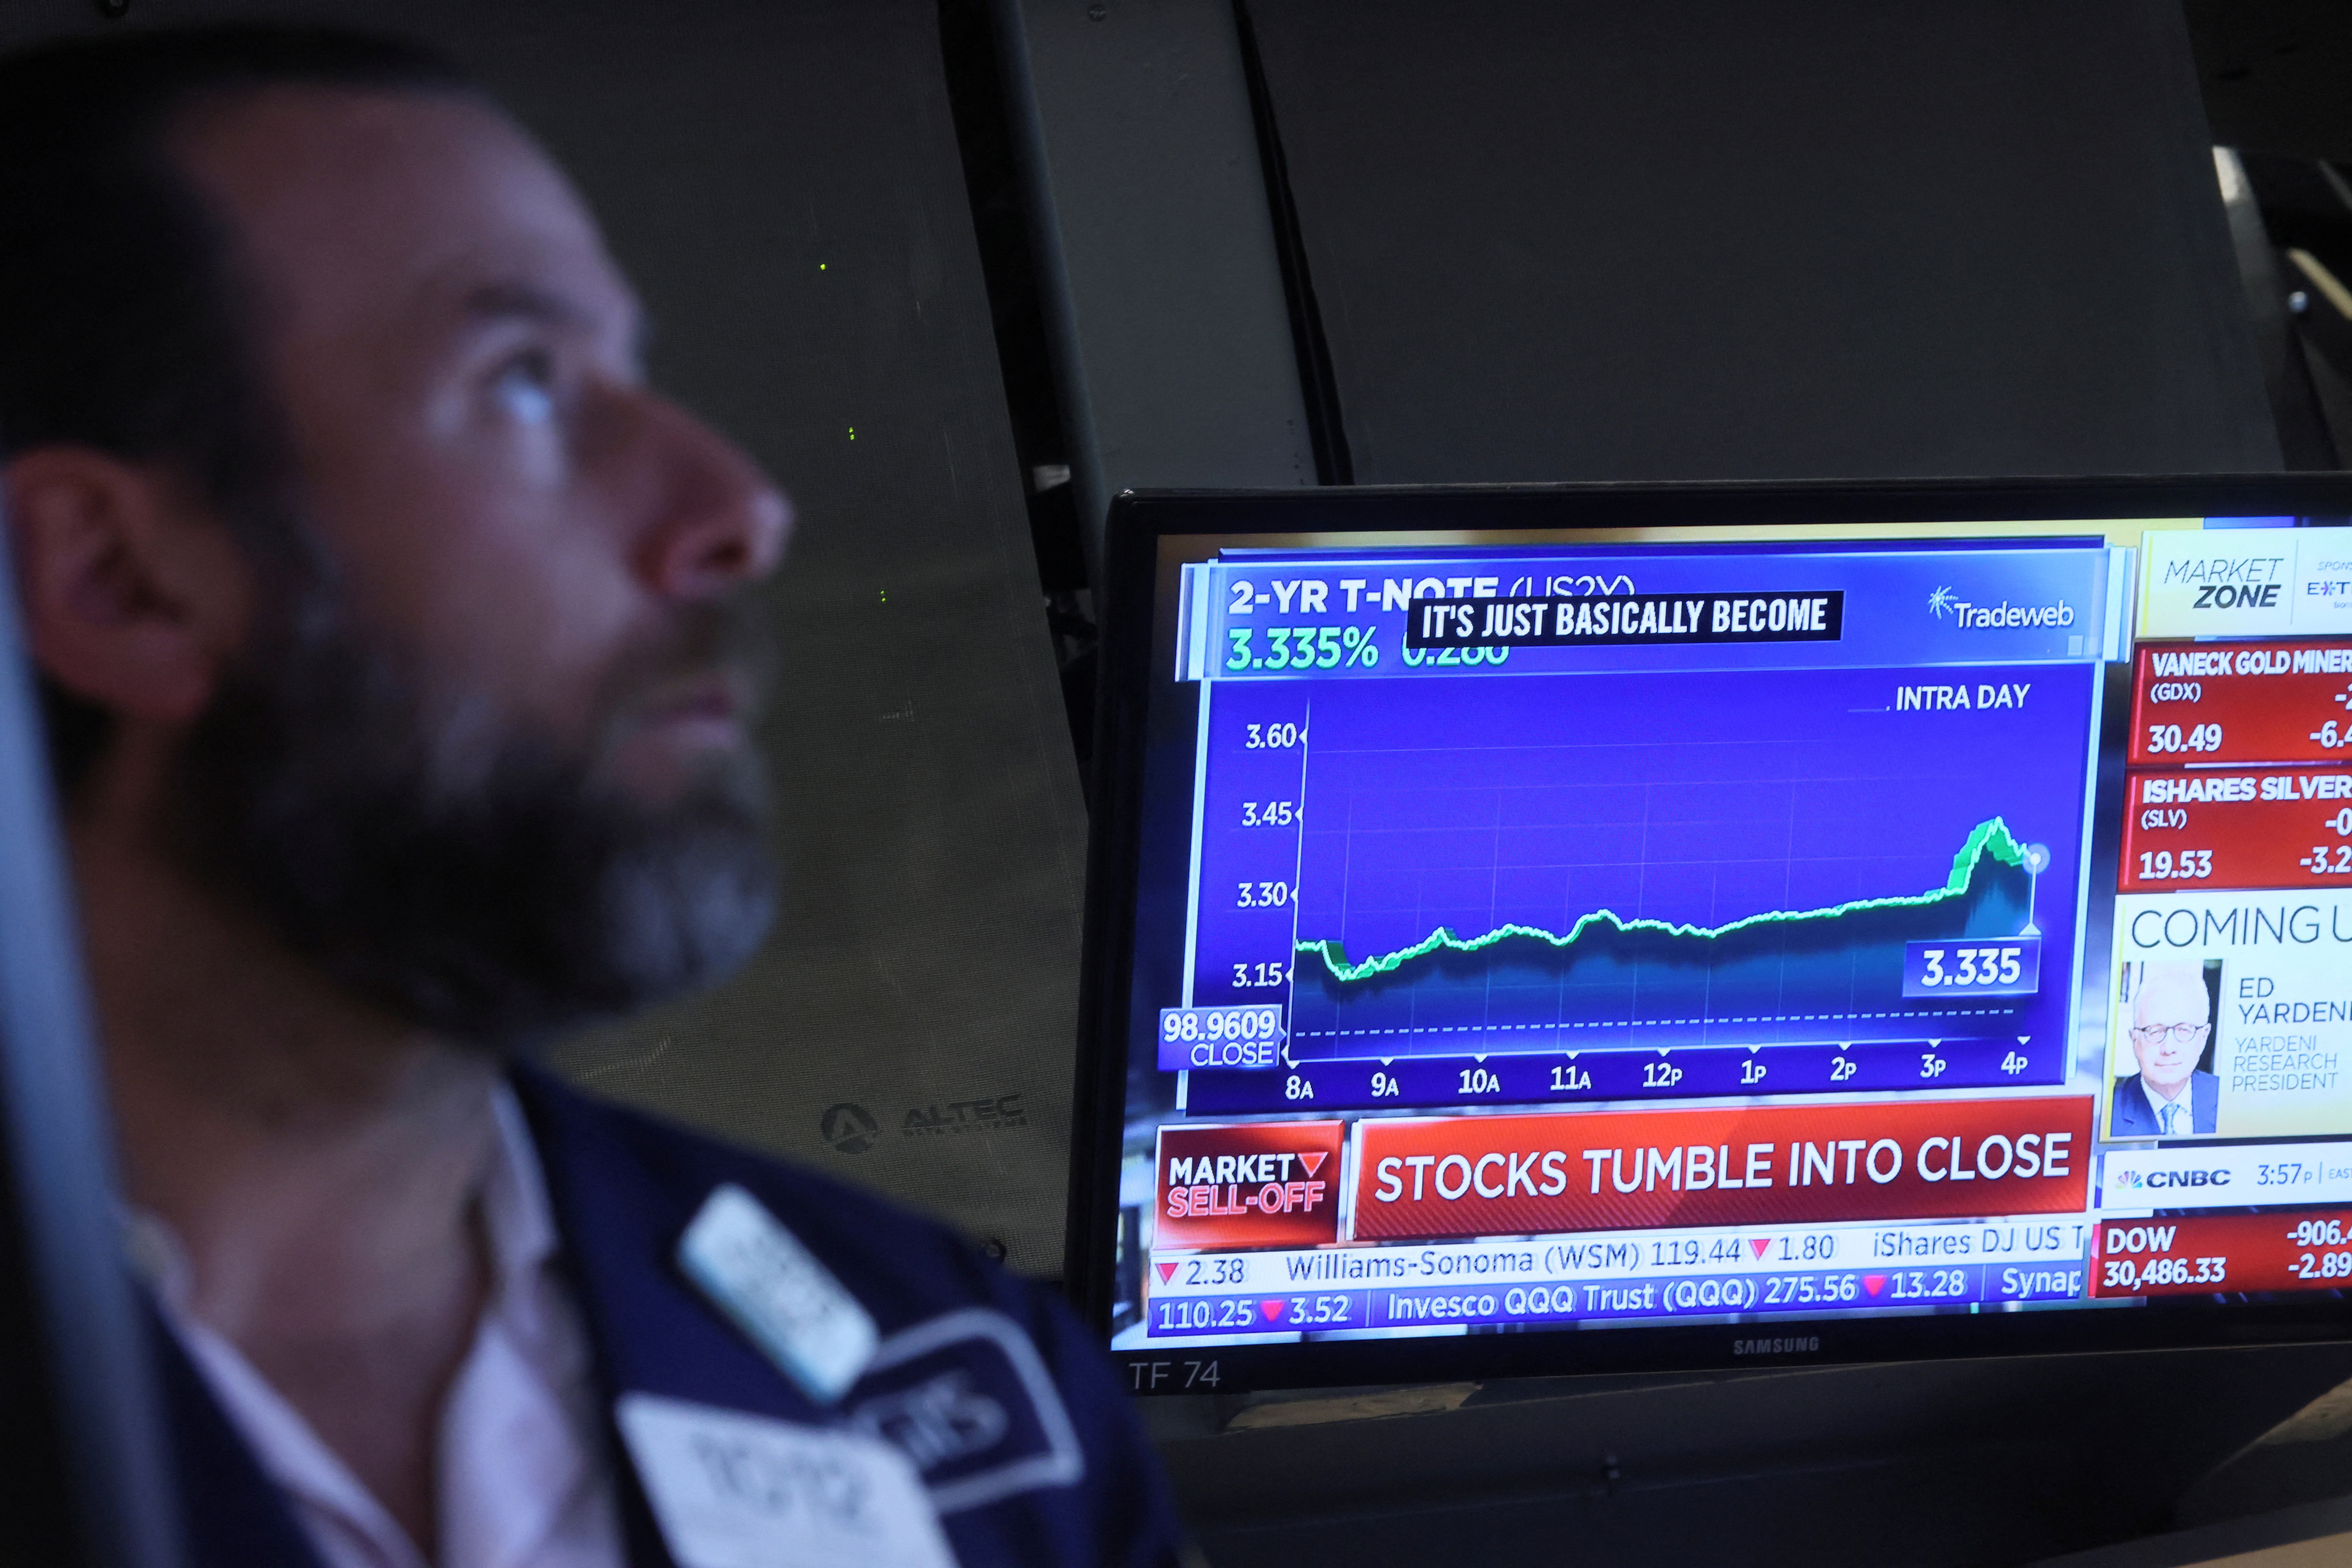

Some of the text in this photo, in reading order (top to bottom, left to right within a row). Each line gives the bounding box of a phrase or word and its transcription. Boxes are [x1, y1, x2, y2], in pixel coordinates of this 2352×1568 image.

[2164, 558, 2284, 584] MARKET
[1228, 580, 1328, 614] 2-YR
[2192, 584, 2281, 609] ZONE
[1422, 598, 1828, 638] IT'S JUST BASICALLY BECOME
[1954, 599, 2075, 628] Tradeweb
[1225, 625, 1379, 671] 3.335%
[2151, 649, 2352, 677] VANECK GOLD MINER
[1896, 683, 2031, 711] INTRA DAY
[2150, 682, 2202, 704] (GDX)
[1245, 722, 1297, 749] 3.60
[2147, 723, 2223, 753] 30.49
[2143, 775, 2352, 804] ISHARES SILVER
[1241, 801, 1292, 827] 3.45
[2141, 808, 2188, 830] (SLV)
[2138, 850, 2213, 880] 19.53
[2299, 845, 2352, 874] -3.2
[1237, 881, 1288, 908] 3.30
[2132, 905, 2320, 948] COMING
[1232, 962, 1283, 988] 3.15
[1921, 947, 2022, 987] 3.335
[2239, 977, 2274, 999] ED
[1163, 1009, 1276, 1042] 98.9609
[1190, 1041, 1274, 1067] CLOSE
[2235, 1035, 2317, 1054] YARDENI
[2233, 1053, 2337, 1073] RESEARCH
[1285, 1075, 1314, 1100] 8A
[1371, 1071, 1399, 1097] 9A
[1458, 1068, 1500, 1094] 10A
[1550, 1065, 1592, 1091] 11A
[2232, 1072, 2339, 1092] PRESIDENT
[903, 1093, 1026, 1129] ALTEC
[1168, 1153, 1295, 1186] MARKET
[1375, 1132, 2072, 1203] STOCKS TUMBLE INTO CLOSE
[2147, 1169, 2231, 1188] CNBC
[2329, 1168, 2352, 1179] EAS
[1167, 1181, 1326, 1219] SELL-OFF
[2106, 1225, 2177, 1255] DOW
[1185, 1225, 2084, 1285] 2.38 Williams-Sonoma (WSM) 119.44 1.80 iShares DJ US T
[2103, 1257, 2227, 1291] 30,486.33
[1158, 1267, 2082, 1330] 110.25 3.52 Invesco QQQ Trust (QQQ) 275.56 13.28 Synap
[1733, 1336, 1820, 1355] SAMSUNG
[1128, 1360, 1221, 1390] TF 74
